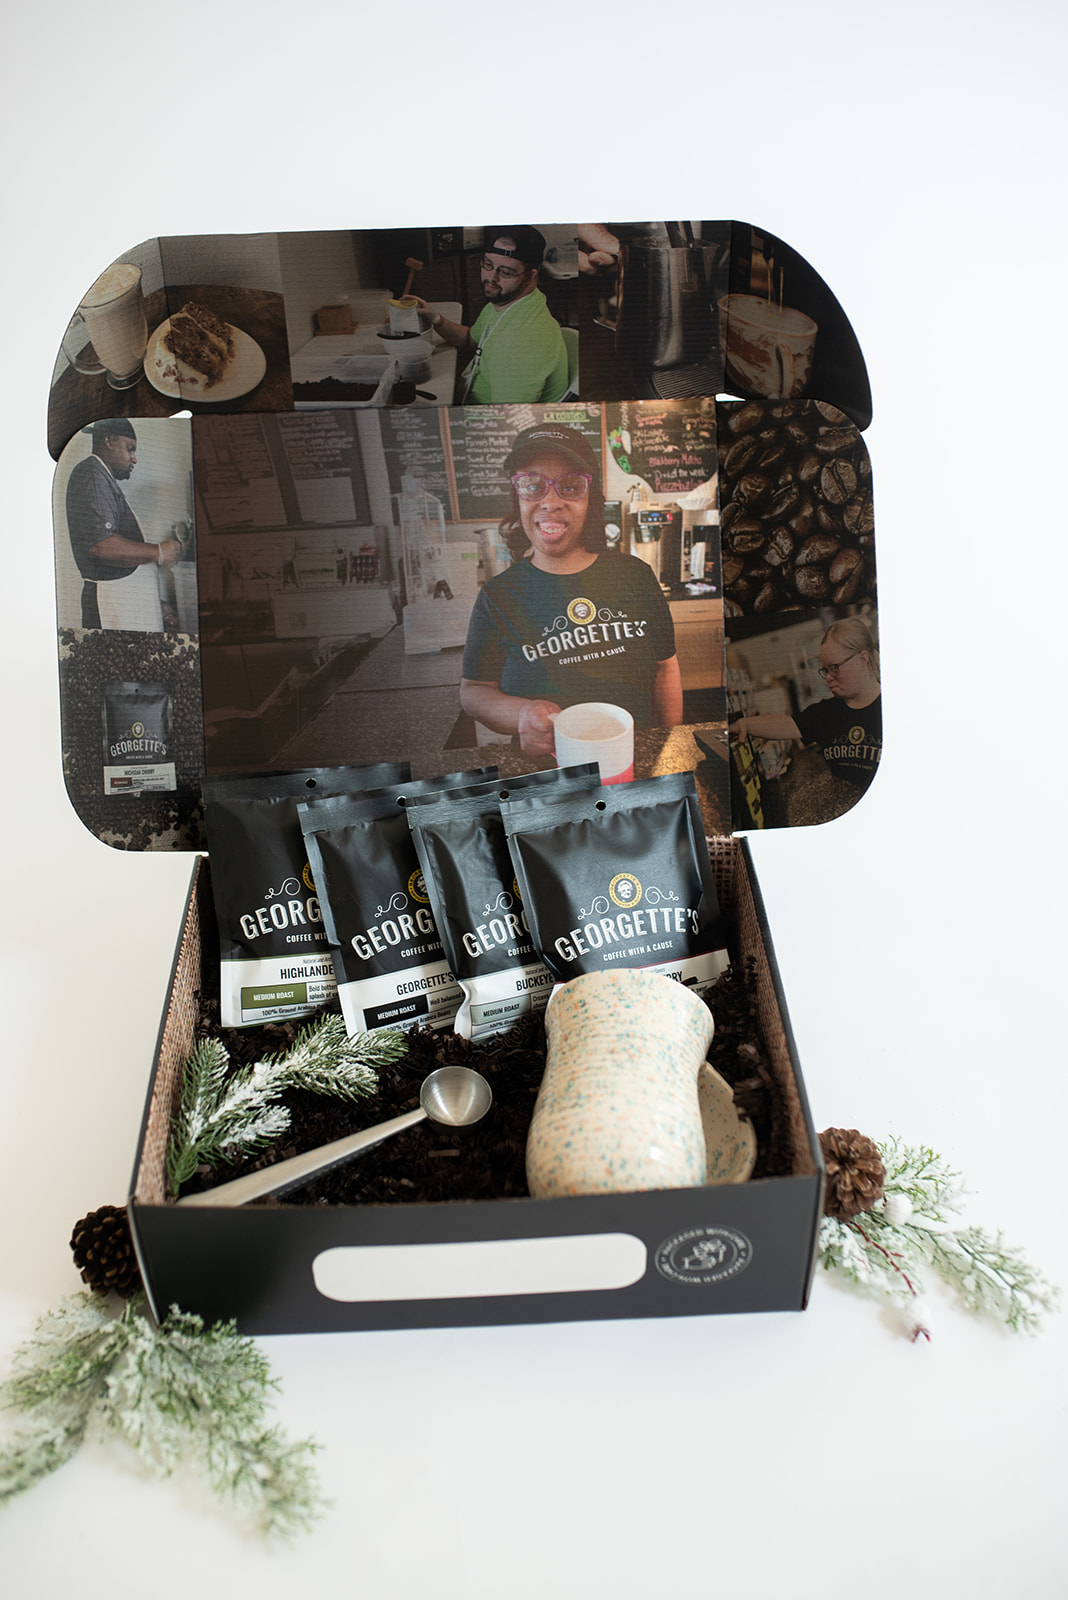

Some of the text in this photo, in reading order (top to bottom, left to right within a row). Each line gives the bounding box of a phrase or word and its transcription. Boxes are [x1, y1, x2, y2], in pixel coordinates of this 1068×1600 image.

[522, 620, 647, 662] GEORGETTE'S
[559, 655, 581, 665] COFFEE
[583, 653, 599, 661] WITH
[606, 645, 626, 656] CAUSE
[110, 739, 167, 757] GEORGETTE'S
[286, 933, 312, 943] COFFEE
[351, 908, 435, 961] GEORG
[554, 907, 699, 963] GEORGETTE'S
[401, 945, 426, 958] COFFEE
[508, 945, 531, 957] COFFEE
[603, 949, 627, 961] COFFEE
[628, 946, 645, 956] WITH
[652, 940, 674, 951] CAUSE
[280, 964, 334, 980] HIGHLANDE
[308, 984, 321, 993] Bold
[396, 971, 455, 996] GEORGETTE'S
[516, 973, 553, 991] BUCKEYE
[253, 991, 295, 1001] MEDIUM ROAST
[262, 1008, 278, 1017] 100%
[278, 1006, 297, 1014] Ground
[377, 1004, 417, 1020] MEDIUM ROAST
[483, 1004, 520, 1017] MEDIUM ROAST
